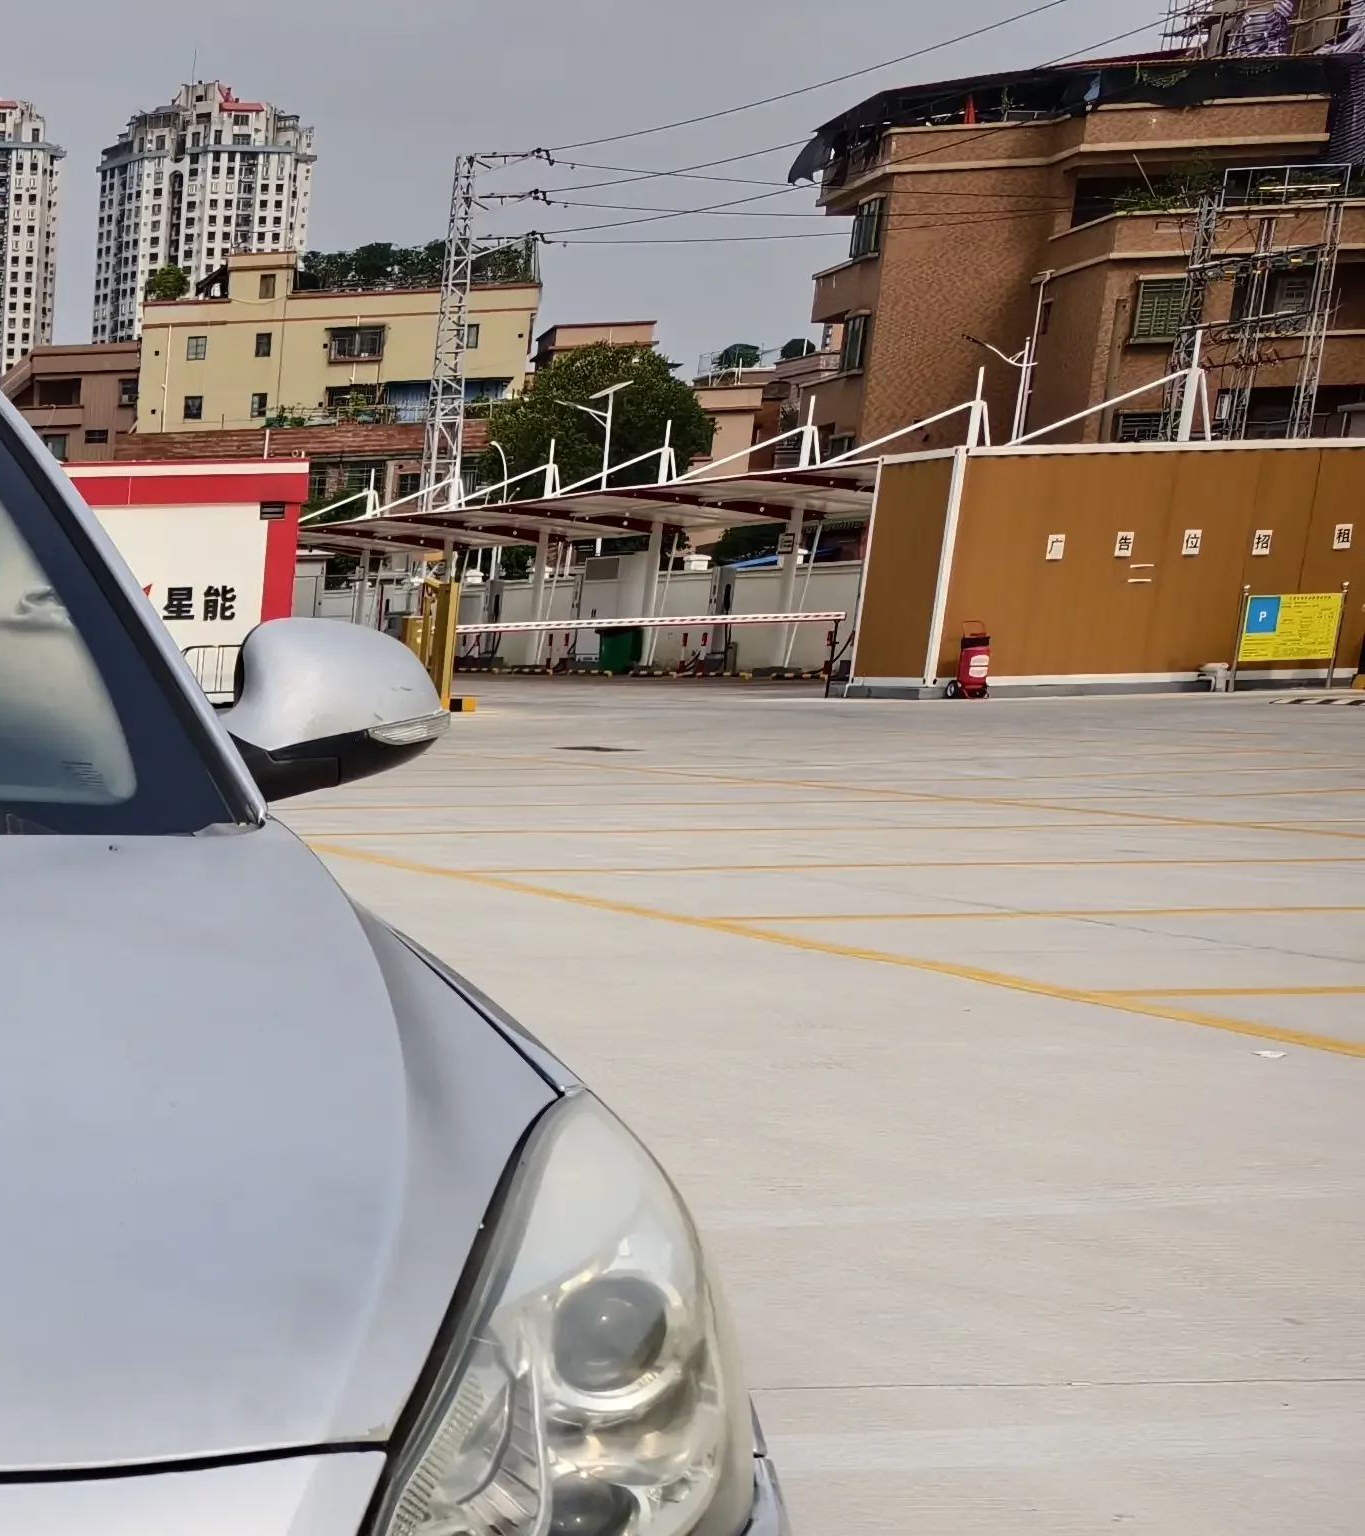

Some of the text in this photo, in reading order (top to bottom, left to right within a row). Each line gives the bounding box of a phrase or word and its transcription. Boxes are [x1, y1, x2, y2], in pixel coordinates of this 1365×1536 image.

[1048, 527, 1352, 555] 广告位招租
[162, 585, 237, 621] 星能
[1258, 611, 1267, 622] P
